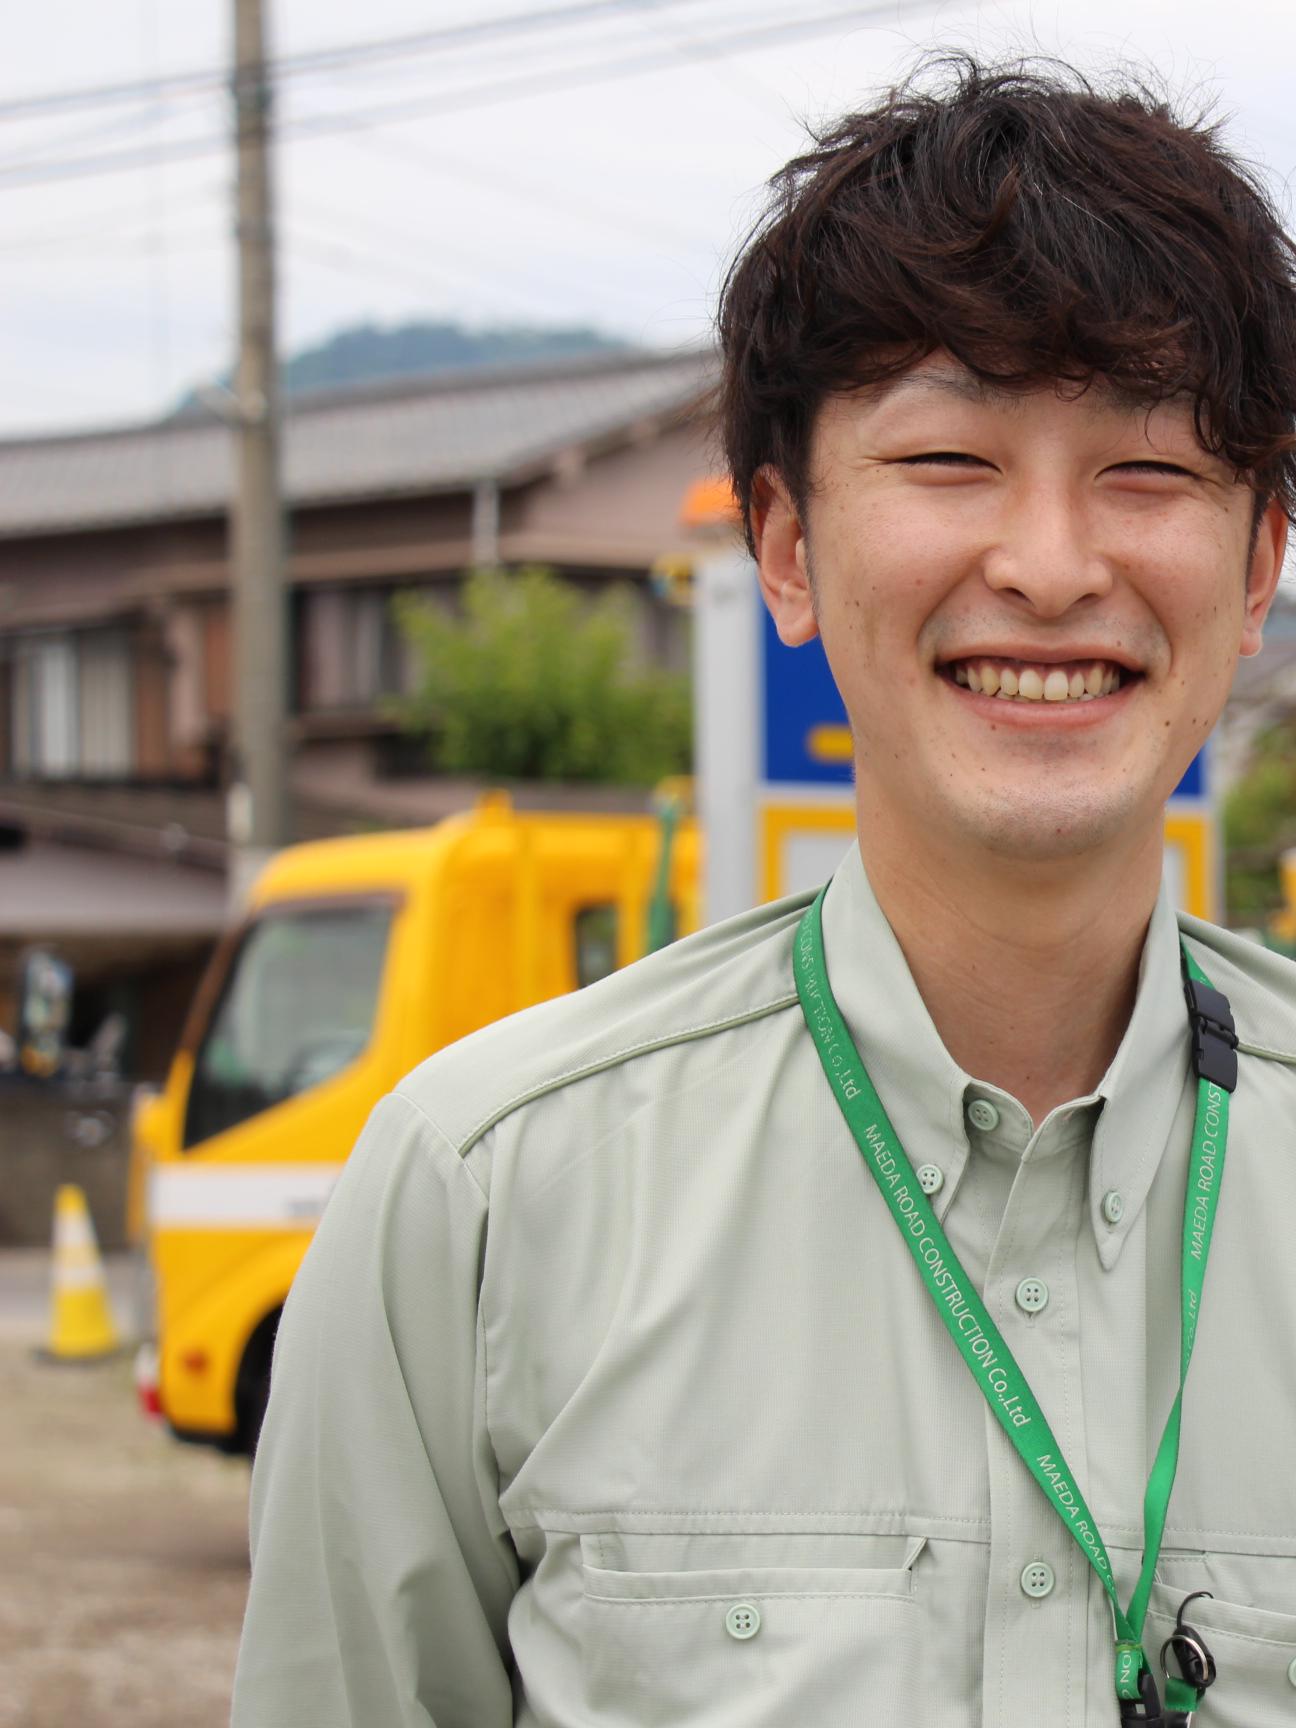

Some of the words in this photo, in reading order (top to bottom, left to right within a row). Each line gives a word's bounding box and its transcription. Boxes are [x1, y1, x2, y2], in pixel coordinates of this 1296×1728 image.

[1204, 1080, 1222, 1138] CONST
[1197, 1141, 1217, 1192] ROAD
[1190, 1196, 1210, 1260] MAEDA
[864, 1123, 902, 1188] MAEDA
[893, 1184, 927, 1238] ROAD
[918, 1236, 998, 1369] CONSTRUCTION
[988, 1366, 1032, 1428] Co.,Ltd
[1036, 1453, 1079, 1519] MAEDA
[1075, 1519, 1108, 1571] ROAD
[1119, 1649, 1133, 1684] ION
